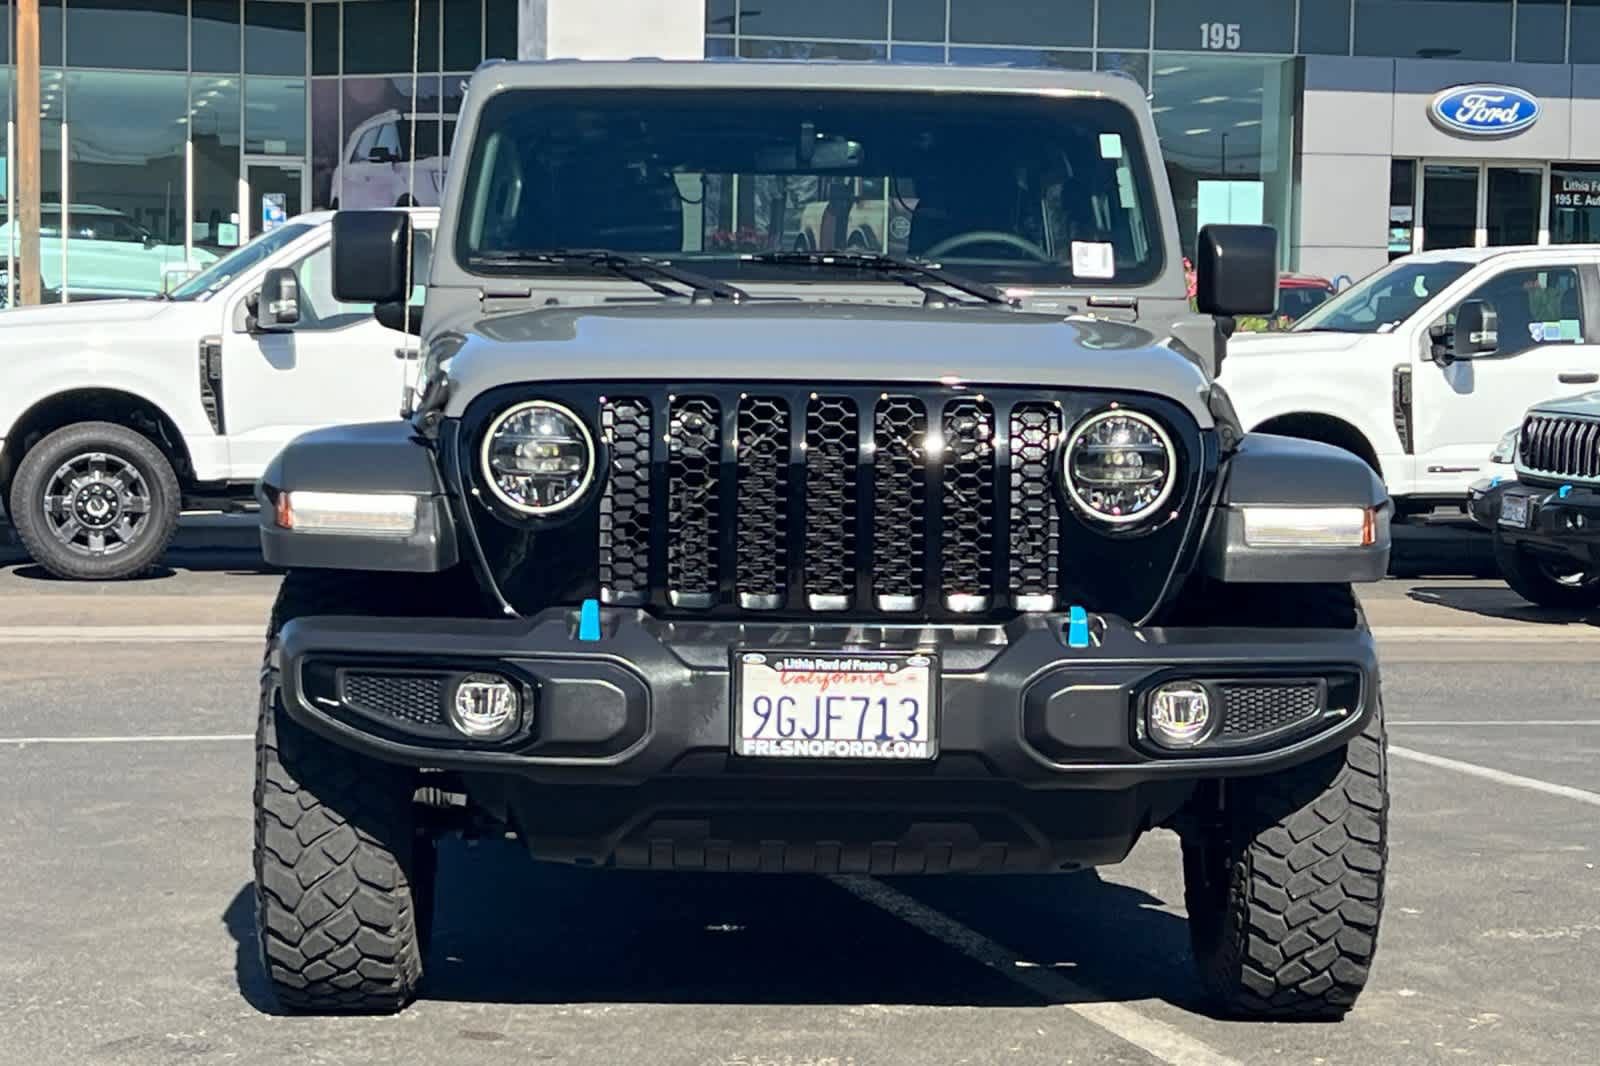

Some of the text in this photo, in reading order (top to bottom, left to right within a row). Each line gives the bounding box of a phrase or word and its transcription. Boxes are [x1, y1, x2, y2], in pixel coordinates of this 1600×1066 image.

[1200, 23, 1241, 50] 195
[1455, 94, 1520, 123] Ford
[1563, 180, 1589, 191] Lithia
[1555, 193, 1571, 205] 195
[784, 658, 888, 671] Lithia Ford of Fresno
[780, 671, 897, 693] California
[753, 695, 920, 741] 9GJF713
[743, 740, 926, 757] FRESNOFORD.COM
